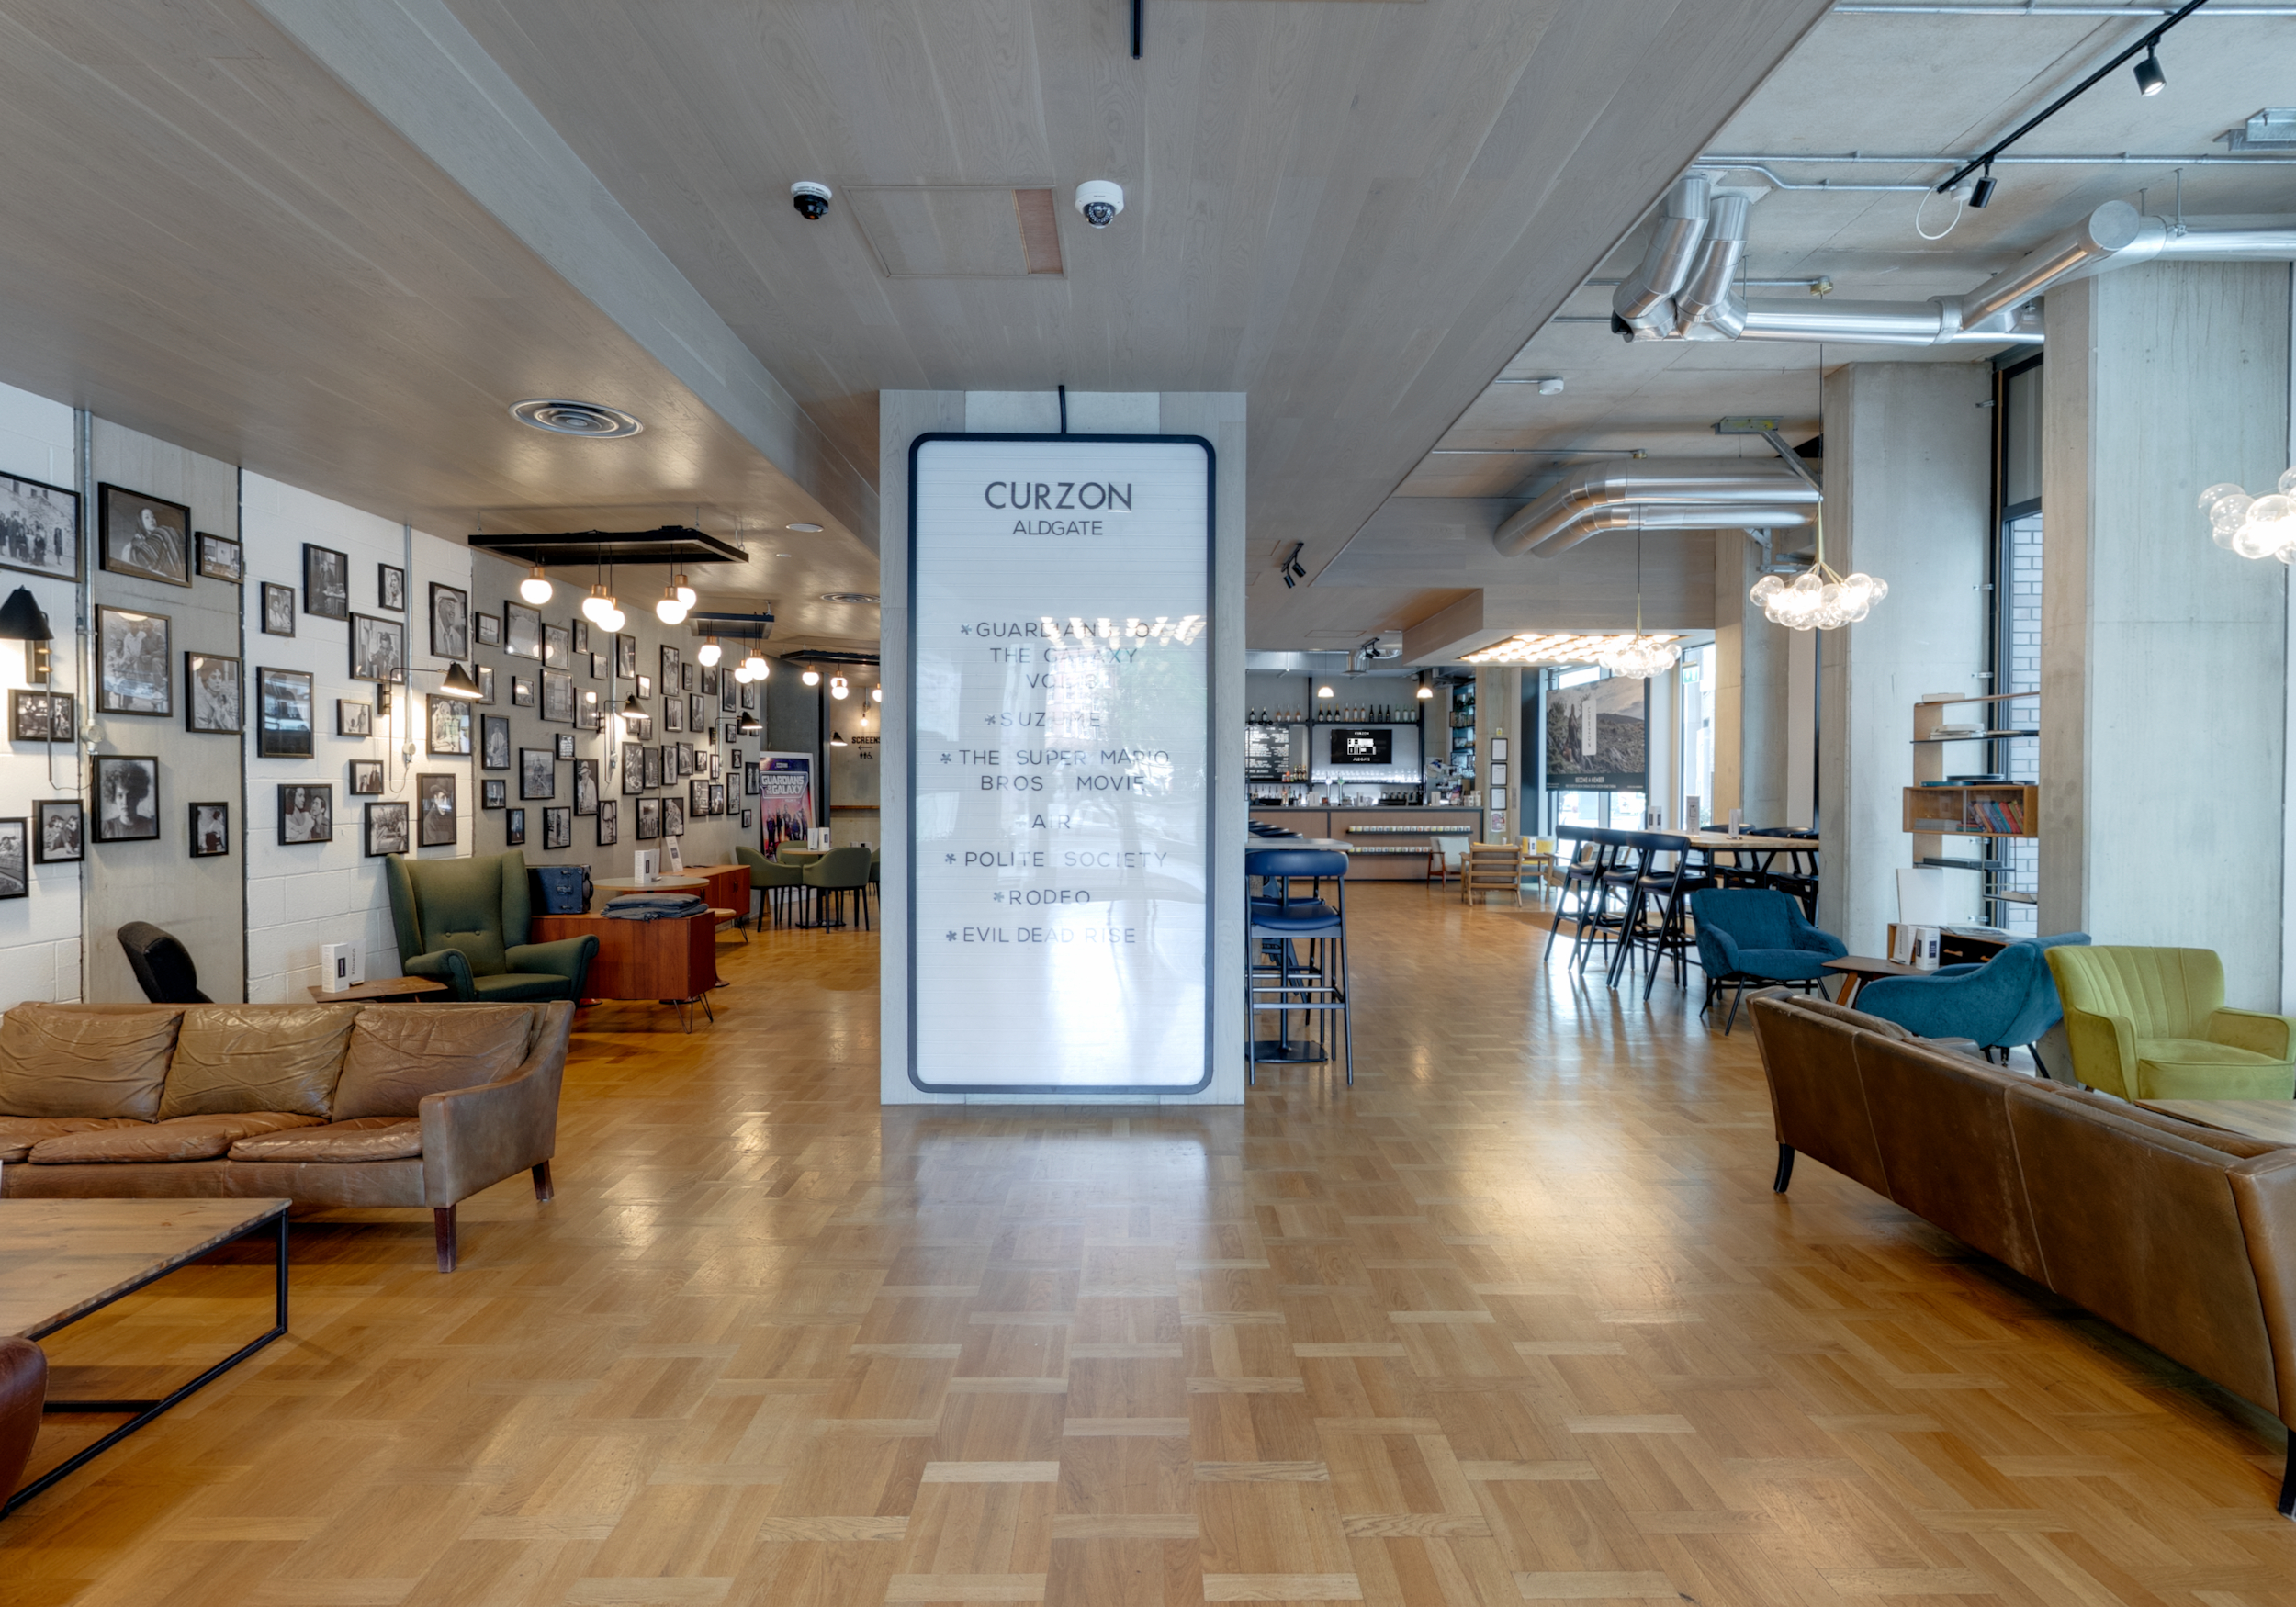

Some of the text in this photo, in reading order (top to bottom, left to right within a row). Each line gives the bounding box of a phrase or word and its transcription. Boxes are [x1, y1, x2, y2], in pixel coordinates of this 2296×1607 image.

[985, 481, 1132, 511] CURZON
[1012, 520, 1104, 536] ALDGATE
[989, 647, 1030, 664] THE
[1000, 712, 1101, 727] SUZUME
[959, 749, 1169, 766] THE SUPER MARIO
[761, 775, 805, 785] GUARDIANS
[980, 775, 1146, 792] BROS MOVIE
[771, 785, 803, 795] GALAXY
[1031, 814, 1072, 829] AIR
[964, 851, 1168, 868] POLITE SOCIETY
[1008, 890, 1091, 905] RODEO
[963, 927, 1137, 943] EVIL DEAD RISE
